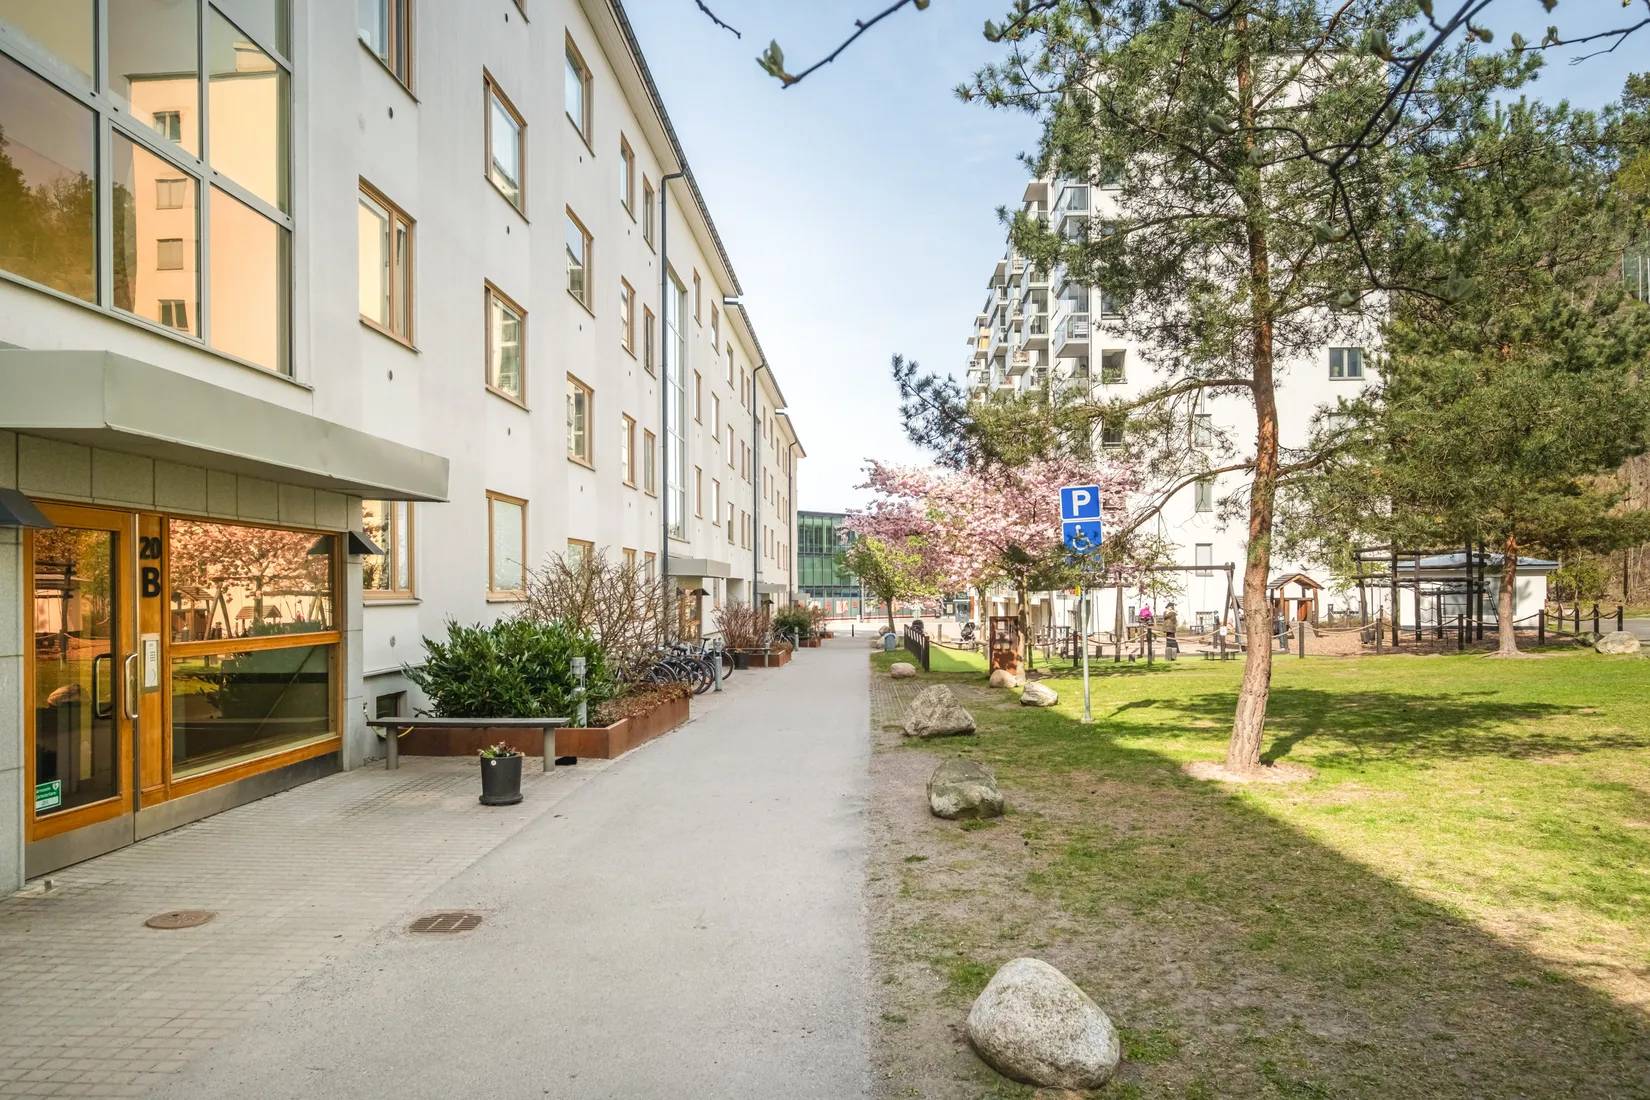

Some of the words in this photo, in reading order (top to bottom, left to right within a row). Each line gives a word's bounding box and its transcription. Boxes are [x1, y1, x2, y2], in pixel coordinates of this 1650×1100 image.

[1072, 490, 1091, 516] P
[140, 536, 162, 560] 20
[142, 567, 161, 598] B
